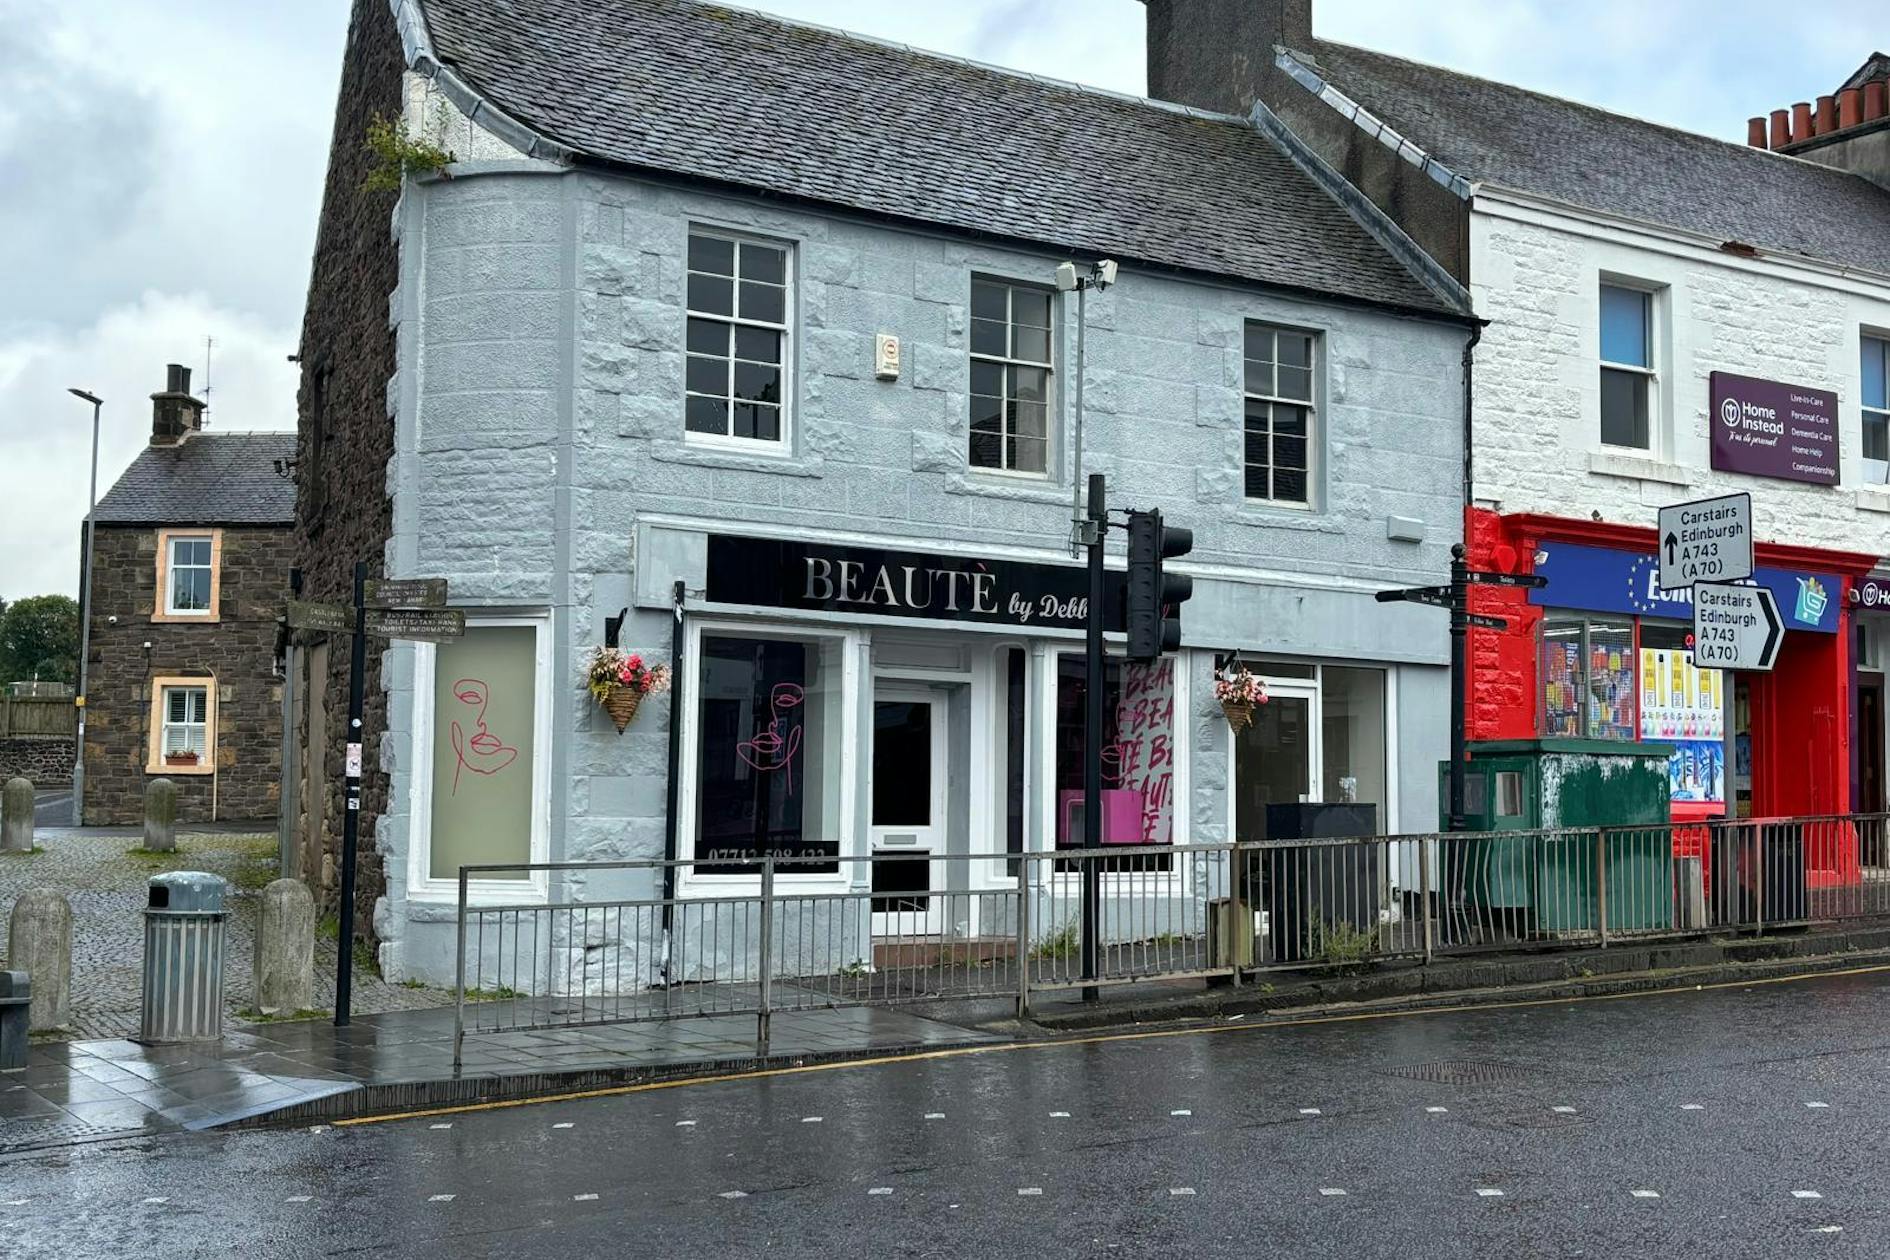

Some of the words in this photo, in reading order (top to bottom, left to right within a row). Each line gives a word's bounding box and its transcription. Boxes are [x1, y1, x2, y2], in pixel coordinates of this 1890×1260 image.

[1742, 401, 1776, 420] Home
[1791, 410, 1815, 422] Personal
[1815, 414, 1830, 424] Care
[1742, 416, 1785, 435] Instead
[1791, 427, 1819, 440] Dementia
[1819, 431, 1833, 442] Care
[1791, 446, 1809, 455] Home
[1792, 462, 1836, 477] Companionship
[1680, 506, 1738, 525] Carstairs
[1681, 522, 1743, 543] Edinburgh
[1682, 542, 1719, 561] A743
[1682, 558, 1723, 579] (A70)
[802, 557, 998, 614] BEAUTÈ
[1008, 591, 1034, 622] by
[1699, 590, 1752, 608] Carstairs
[1700, 609, 1757, 627] Edinburgh
[377, 625, 407, 633] TOURIST
[1700, 627, 1735, 642] A743
[1700, 644, 1739, 661] (A70)
